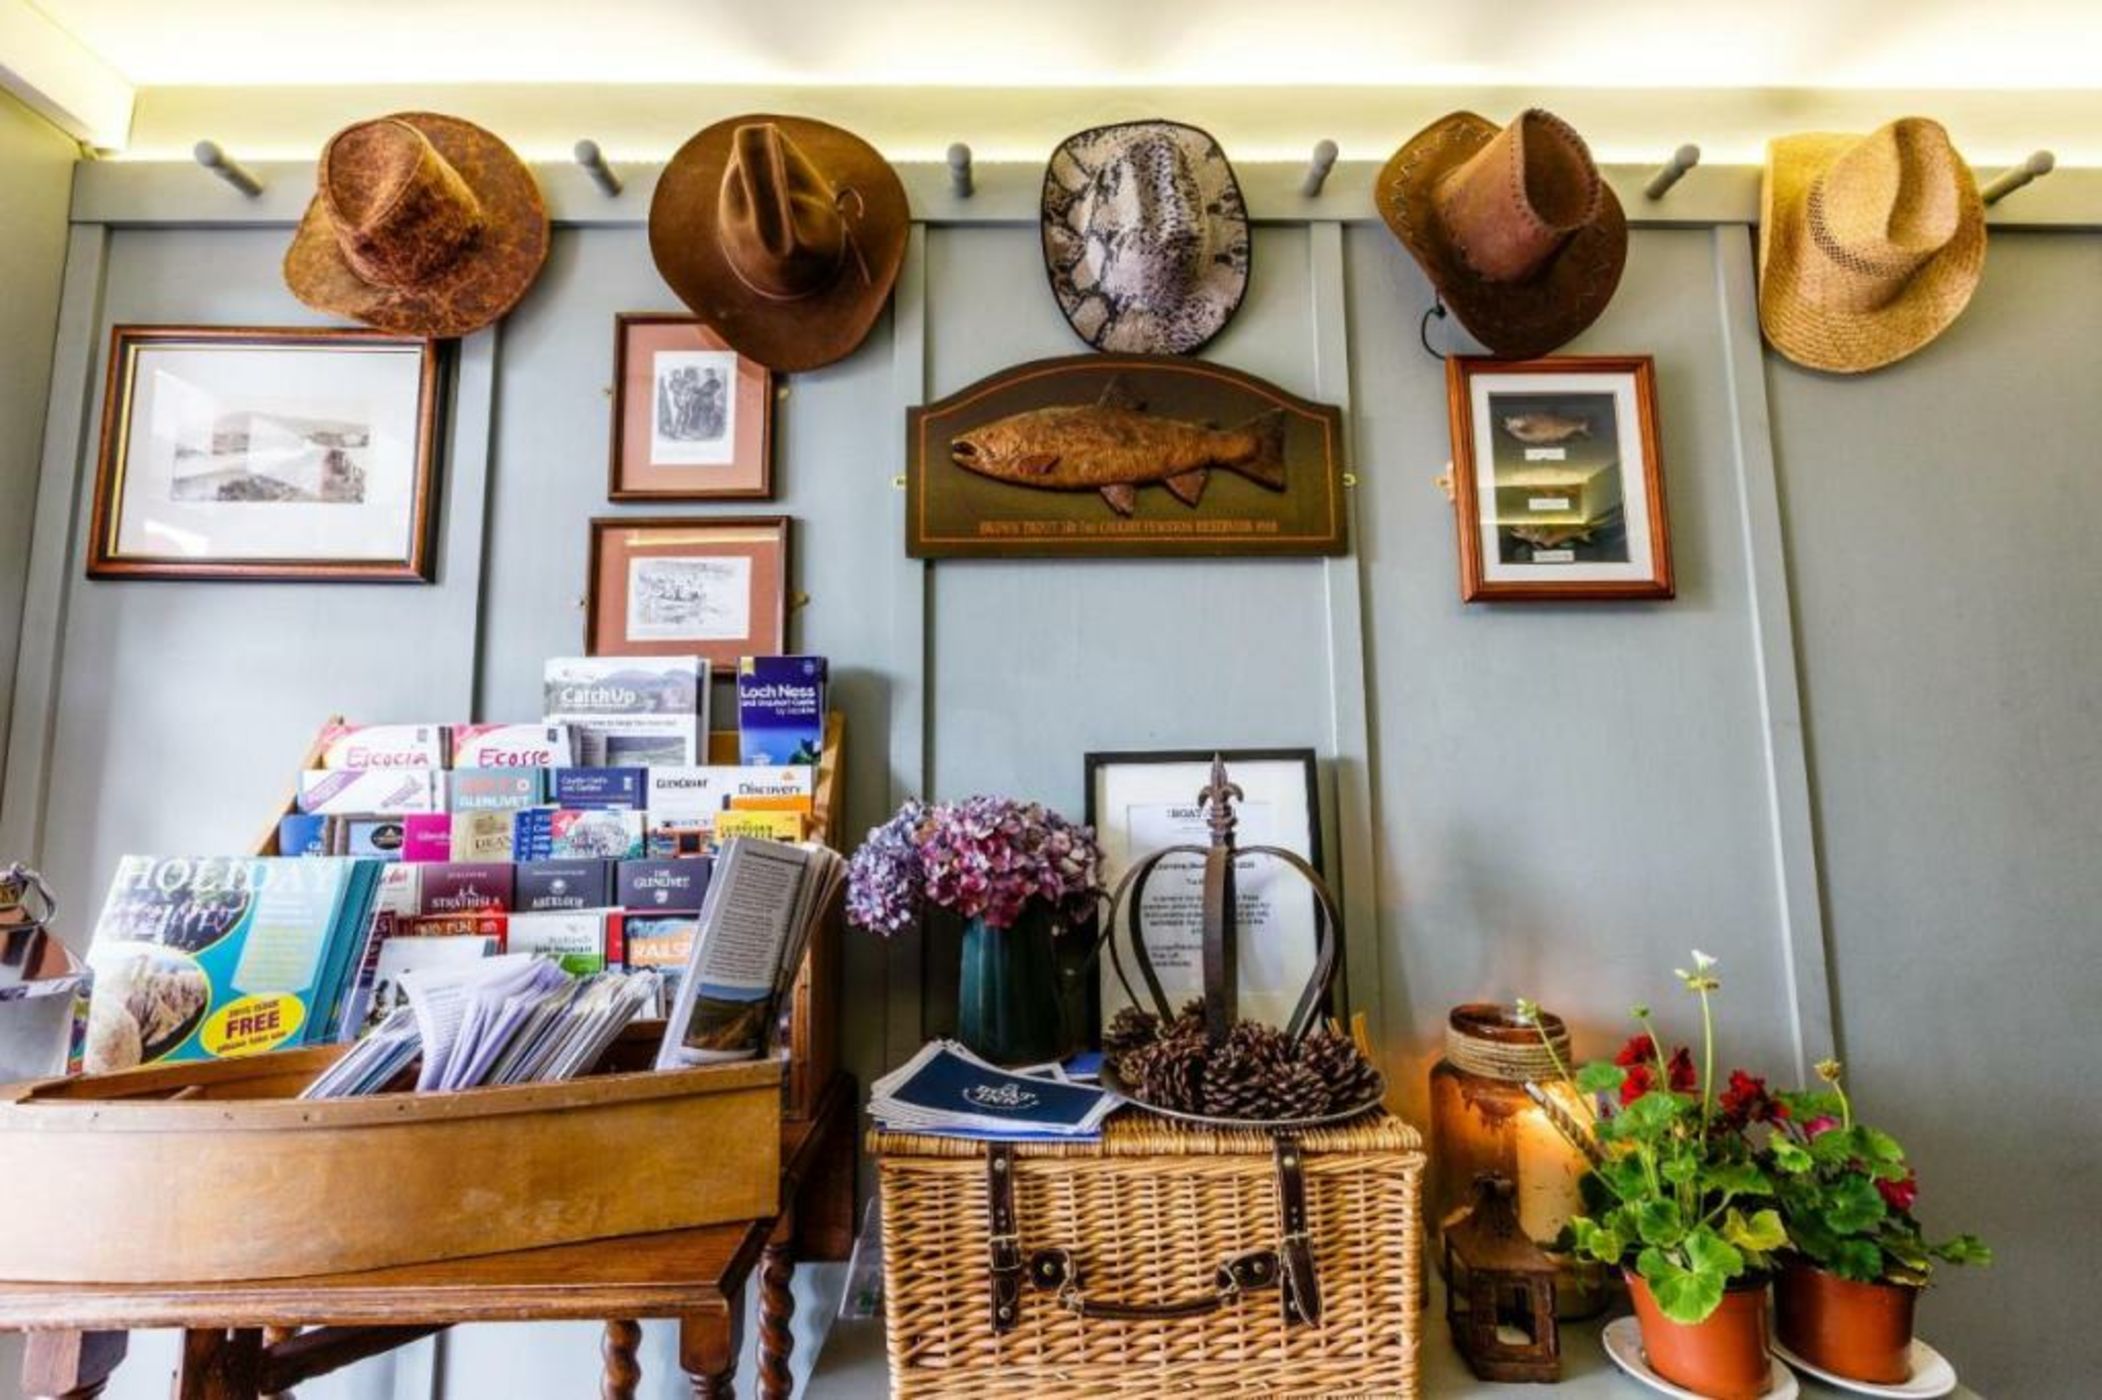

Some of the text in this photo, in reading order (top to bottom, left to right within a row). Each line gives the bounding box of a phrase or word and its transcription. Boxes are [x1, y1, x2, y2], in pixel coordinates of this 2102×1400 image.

[740, 684, 816, 698] Loch Ness
[346, 746, 430, 769] Escocia
[478, 747, 552, 769] Ecosse
[738, 782, 801, 796] Discovery
[225, 1010, 280, 1040] FREE
